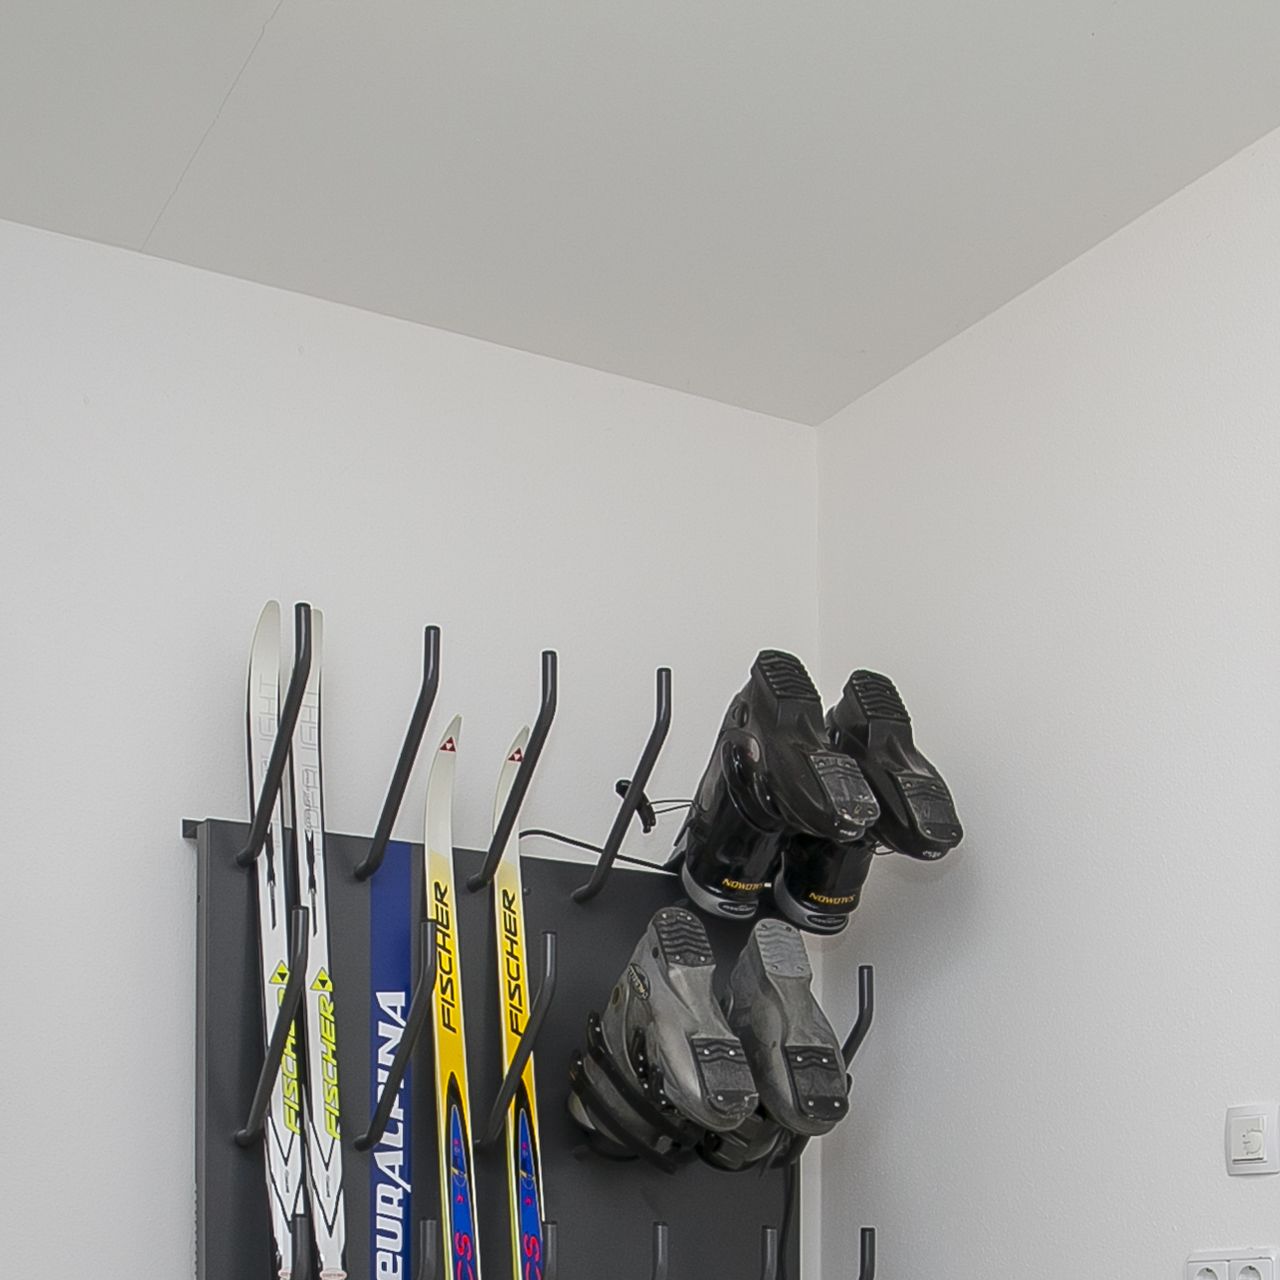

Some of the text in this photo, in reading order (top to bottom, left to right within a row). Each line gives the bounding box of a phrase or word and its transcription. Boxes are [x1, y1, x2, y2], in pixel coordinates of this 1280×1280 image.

[433, 881, 457, 1035] FISCHER
[502, 888, 524, 1037] FISCHER
[318, 993, 341, 1140] FISCHER
